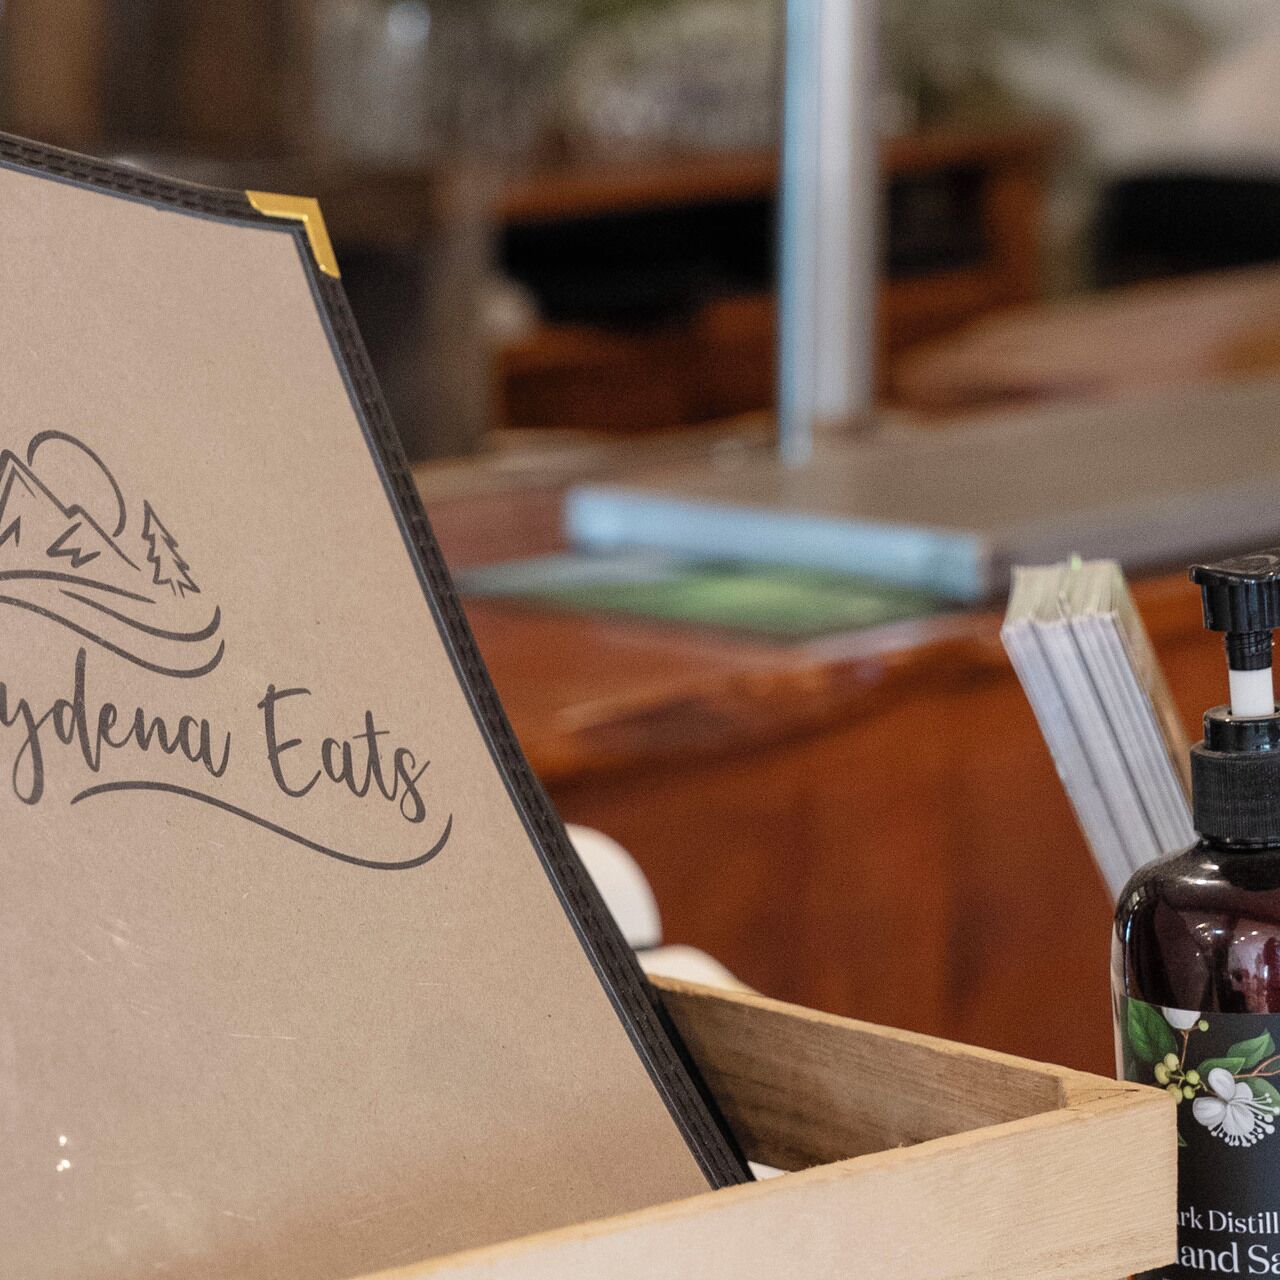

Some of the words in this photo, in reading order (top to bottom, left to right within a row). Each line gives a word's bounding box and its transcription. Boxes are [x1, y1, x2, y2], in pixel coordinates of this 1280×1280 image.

[257, 683, 431, 824] Eats
[1178, 1205, 1204, 1230] rk
[1176, 1241, 1240, 1274] and
